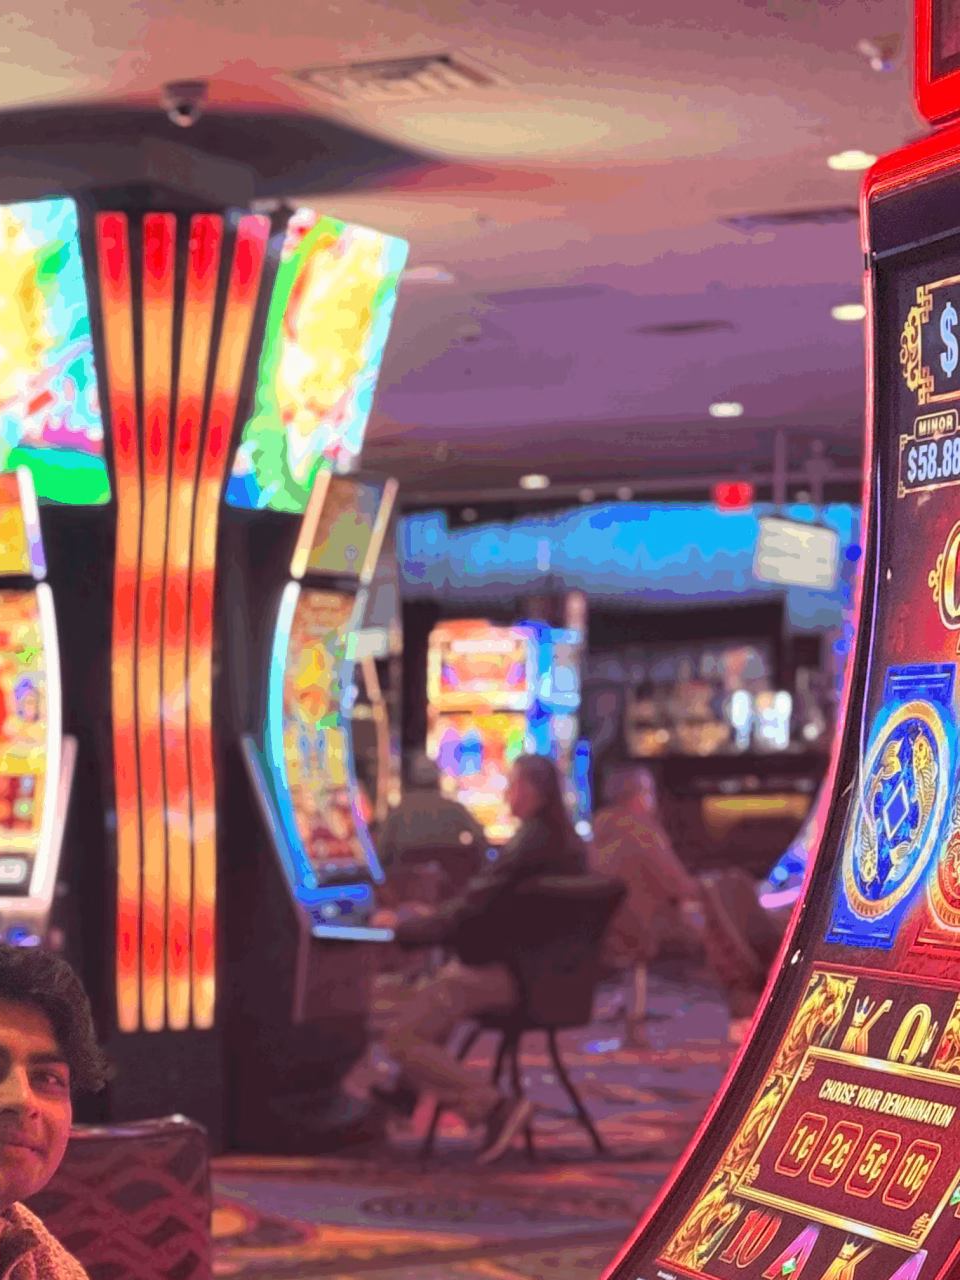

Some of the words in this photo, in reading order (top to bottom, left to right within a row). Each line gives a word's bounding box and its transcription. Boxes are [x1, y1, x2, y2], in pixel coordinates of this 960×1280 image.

[918, 416, 954, 437] MINOR
[907, 437, 960, 483] $58.88
[840, 995, 893, 1056] K
[818, 1079, 856, 1105] CHOOSE
[853, 1087, 884, 1110] YOUR
[879, 1092, 956, 1128] DENOMINATION
[790, 1126, 817, 1163] 1¢
[821, 1133, 852, 1173] 2¢
[858, 1143, 890, 1184] 5¢
[897, 1153, 932, 1196] 10¢
[719, 1207, 782, 1268] 10
